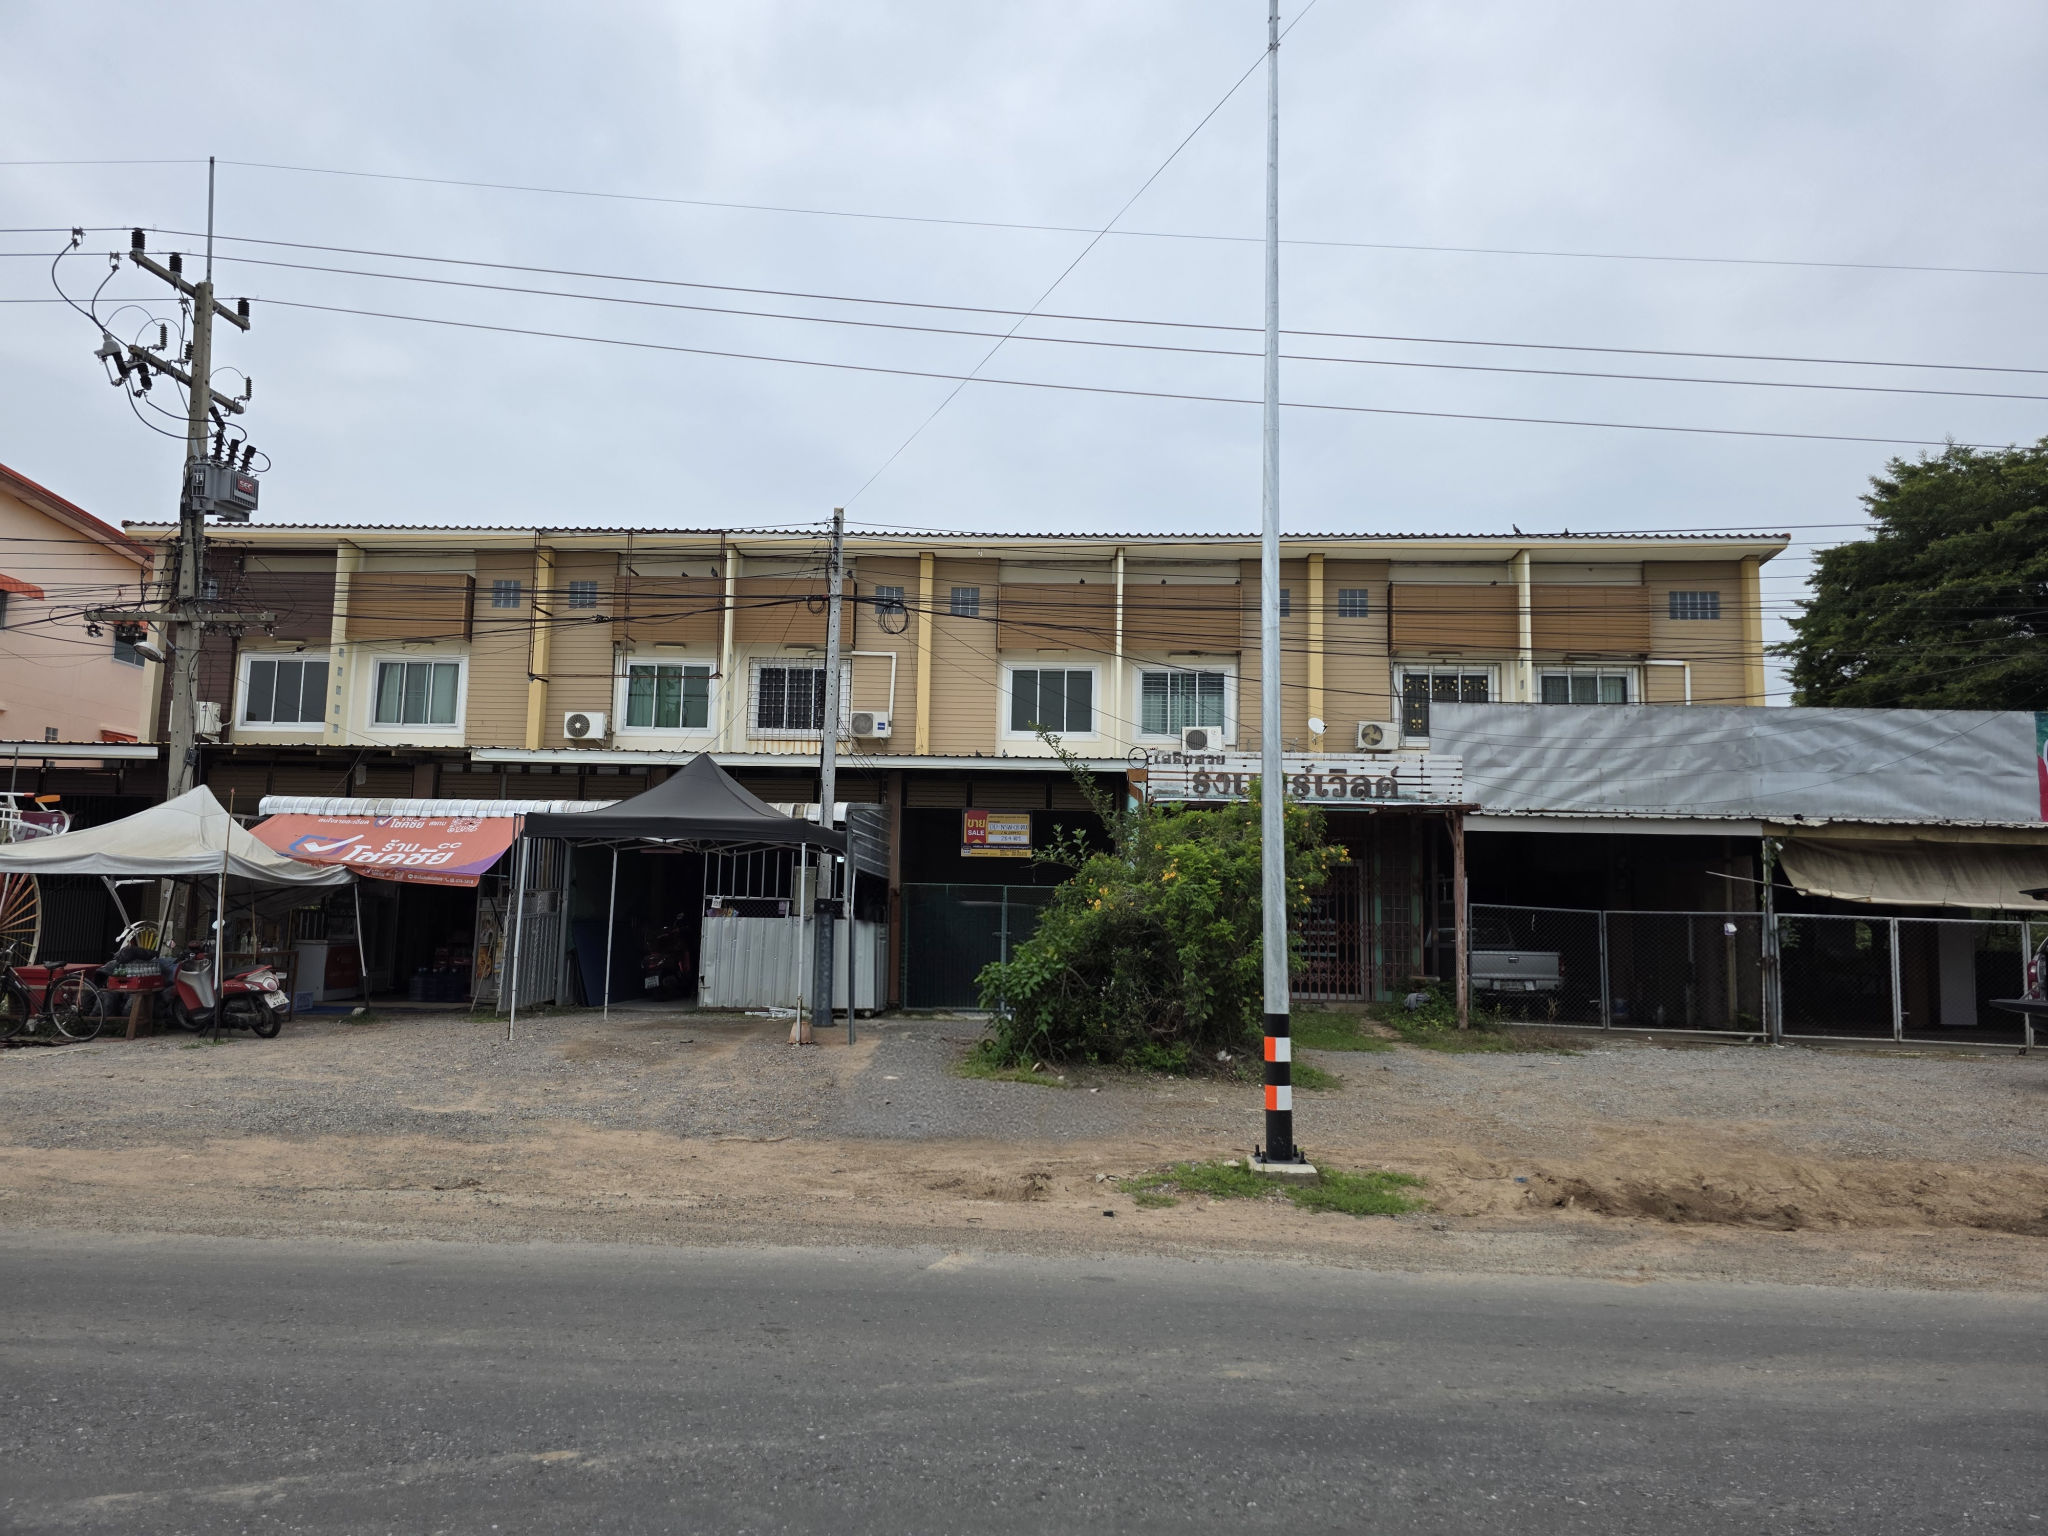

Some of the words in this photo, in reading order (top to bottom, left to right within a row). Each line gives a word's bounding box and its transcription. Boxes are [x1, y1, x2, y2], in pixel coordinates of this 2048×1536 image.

[968, 819, 985, 828] ขาย
[381, 839, 420, 853] ร้าน
[341, 843, 455, 865] โชคชัย
